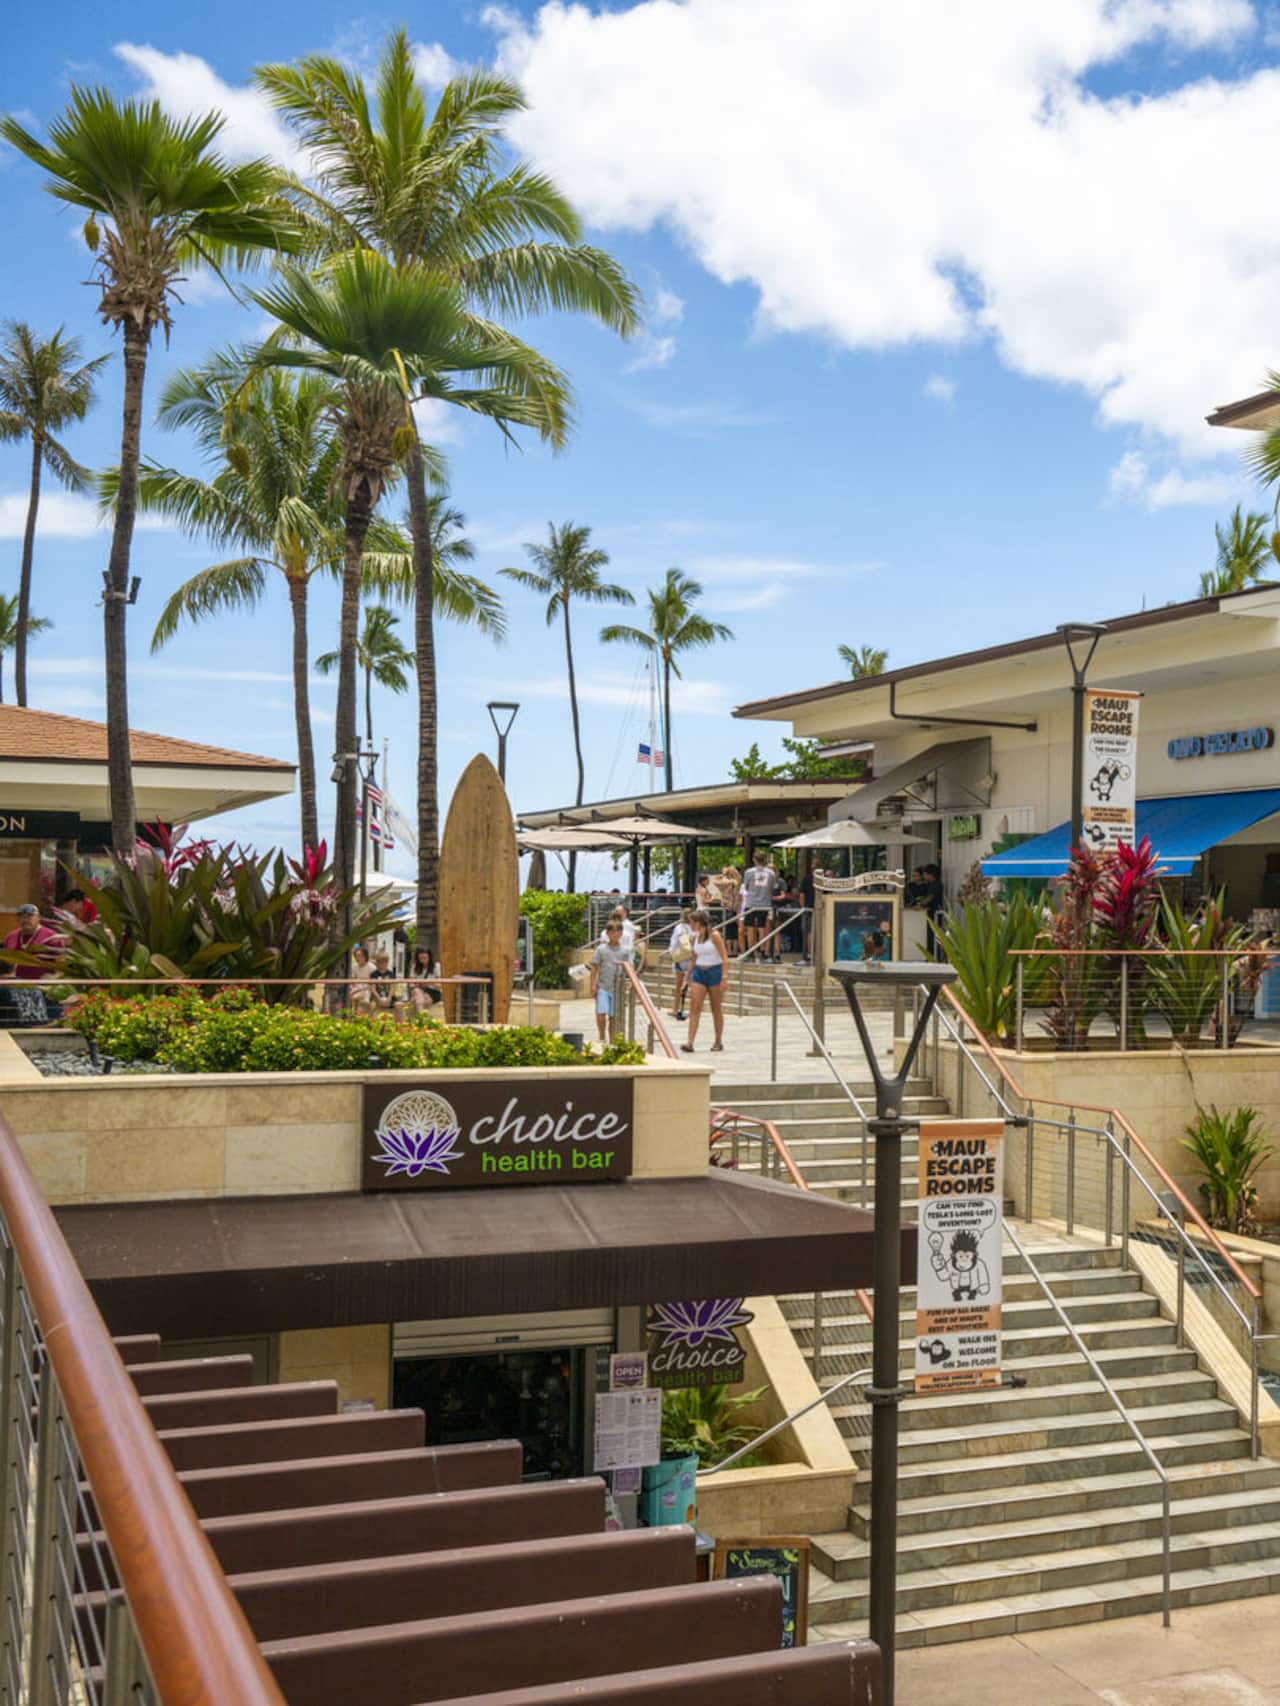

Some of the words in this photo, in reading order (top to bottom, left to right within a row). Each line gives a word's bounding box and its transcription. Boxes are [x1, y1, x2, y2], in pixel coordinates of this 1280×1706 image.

[1095, 698, 1129, 711] MAUI
[1091, 710, 1133, 724] ESCAPE
[1090, 723, 1132, 737] ROOMS
[469, 1097, 628, 1145] choice
[937, 1139, 986, 1157] MAUI
[481, 1149, 562, 1173] health
[572, 1148, 614, 1169] bar
[926, 1157, 996, 1176] ESCAPE
[926, 1177, 995, 1196] ROOMS
[652, 1341, 745, 1372] choice
[959, 1346, 997, 1356] WELCOME
[615, 1367, 642, 1377] OPEN
[653, 1371, 706, 1387] health
[712, 1368, 741, 1384] bar
